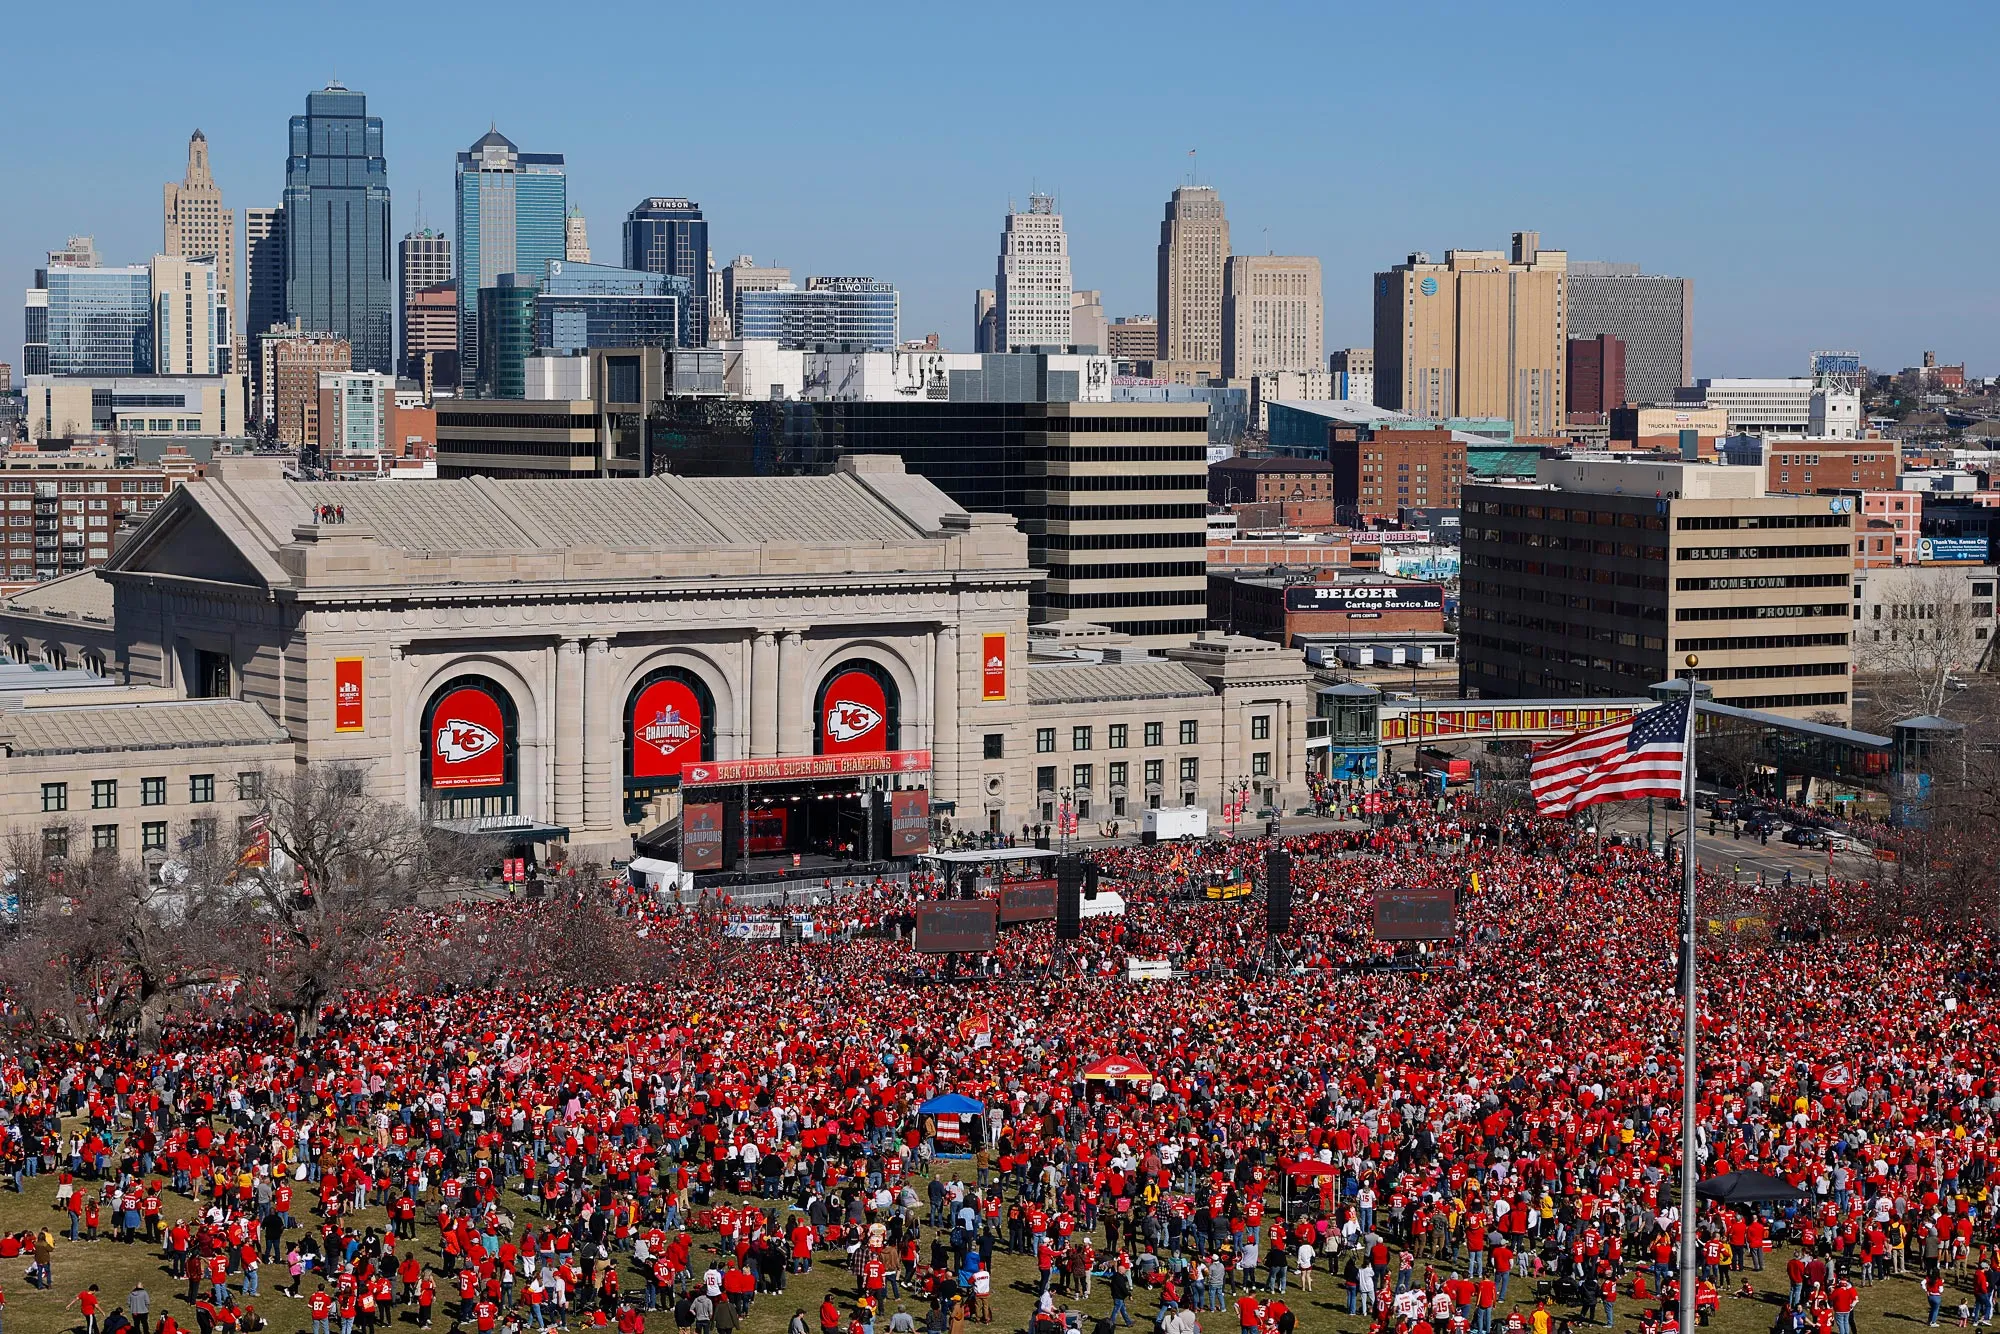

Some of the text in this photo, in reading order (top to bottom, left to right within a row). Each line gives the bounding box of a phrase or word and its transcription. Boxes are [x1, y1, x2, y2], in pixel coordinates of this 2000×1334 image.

[552, 261, 562, 275] 3
[1691, 548, 1757, 559] BLUE KC
[1710, 577, 1785, 589] HOMETOWN
[1315, 588, 1398, 599] BELGER
[1757, 606, 1803, 618] PROUD
[841, 709, 869, 730] KC
[1383, 713, 1433, 737] BACK
[1455, 712, 1475, 730] TO
[1496, 712, 1545, 729] BACK
[646, 725, 689, 740] CHAMPIONS
[452, 729, 484, 751] KC
[718, 762, 780, 780] BACK-TO-BACK
[784, 762, 811, 775] SUPER
[813, 760, 838, 774] BOWL
[841, 757, 891, 772] CHAMPIONS
[481, 815, 532, 828] KANSAS CITY
[893, 817, 928, 830] CHAMPIONS
[685, 831, 722, 844] CHAMPIONS
[170, 1144, 178, 1152] 15
[447, 1187, 455, 1195] 15
[125, 1200, 135, 1208] 38
[147, 1201, 156, 1209] 19
[721, 1216, 728, 1224] 15
[1586, 1238, 1593, 1247] 15
[1709, 1247, 1717, 1257] 15
[218, 1264, 225, 1272] 15
[660, 1268, 668, 1276] 10
[870, 1269, 878, 1277] 15
[707, 1277, 715, 1285] 15
[314, 1301, 323, 1311] 87
[1401, 1302, 1410, 1311] 15
[1438, 1302, 1447, 1311] 15
[480, 1308, 489, 1317] 15
[1509, 1320, 1520, 1329] 95
